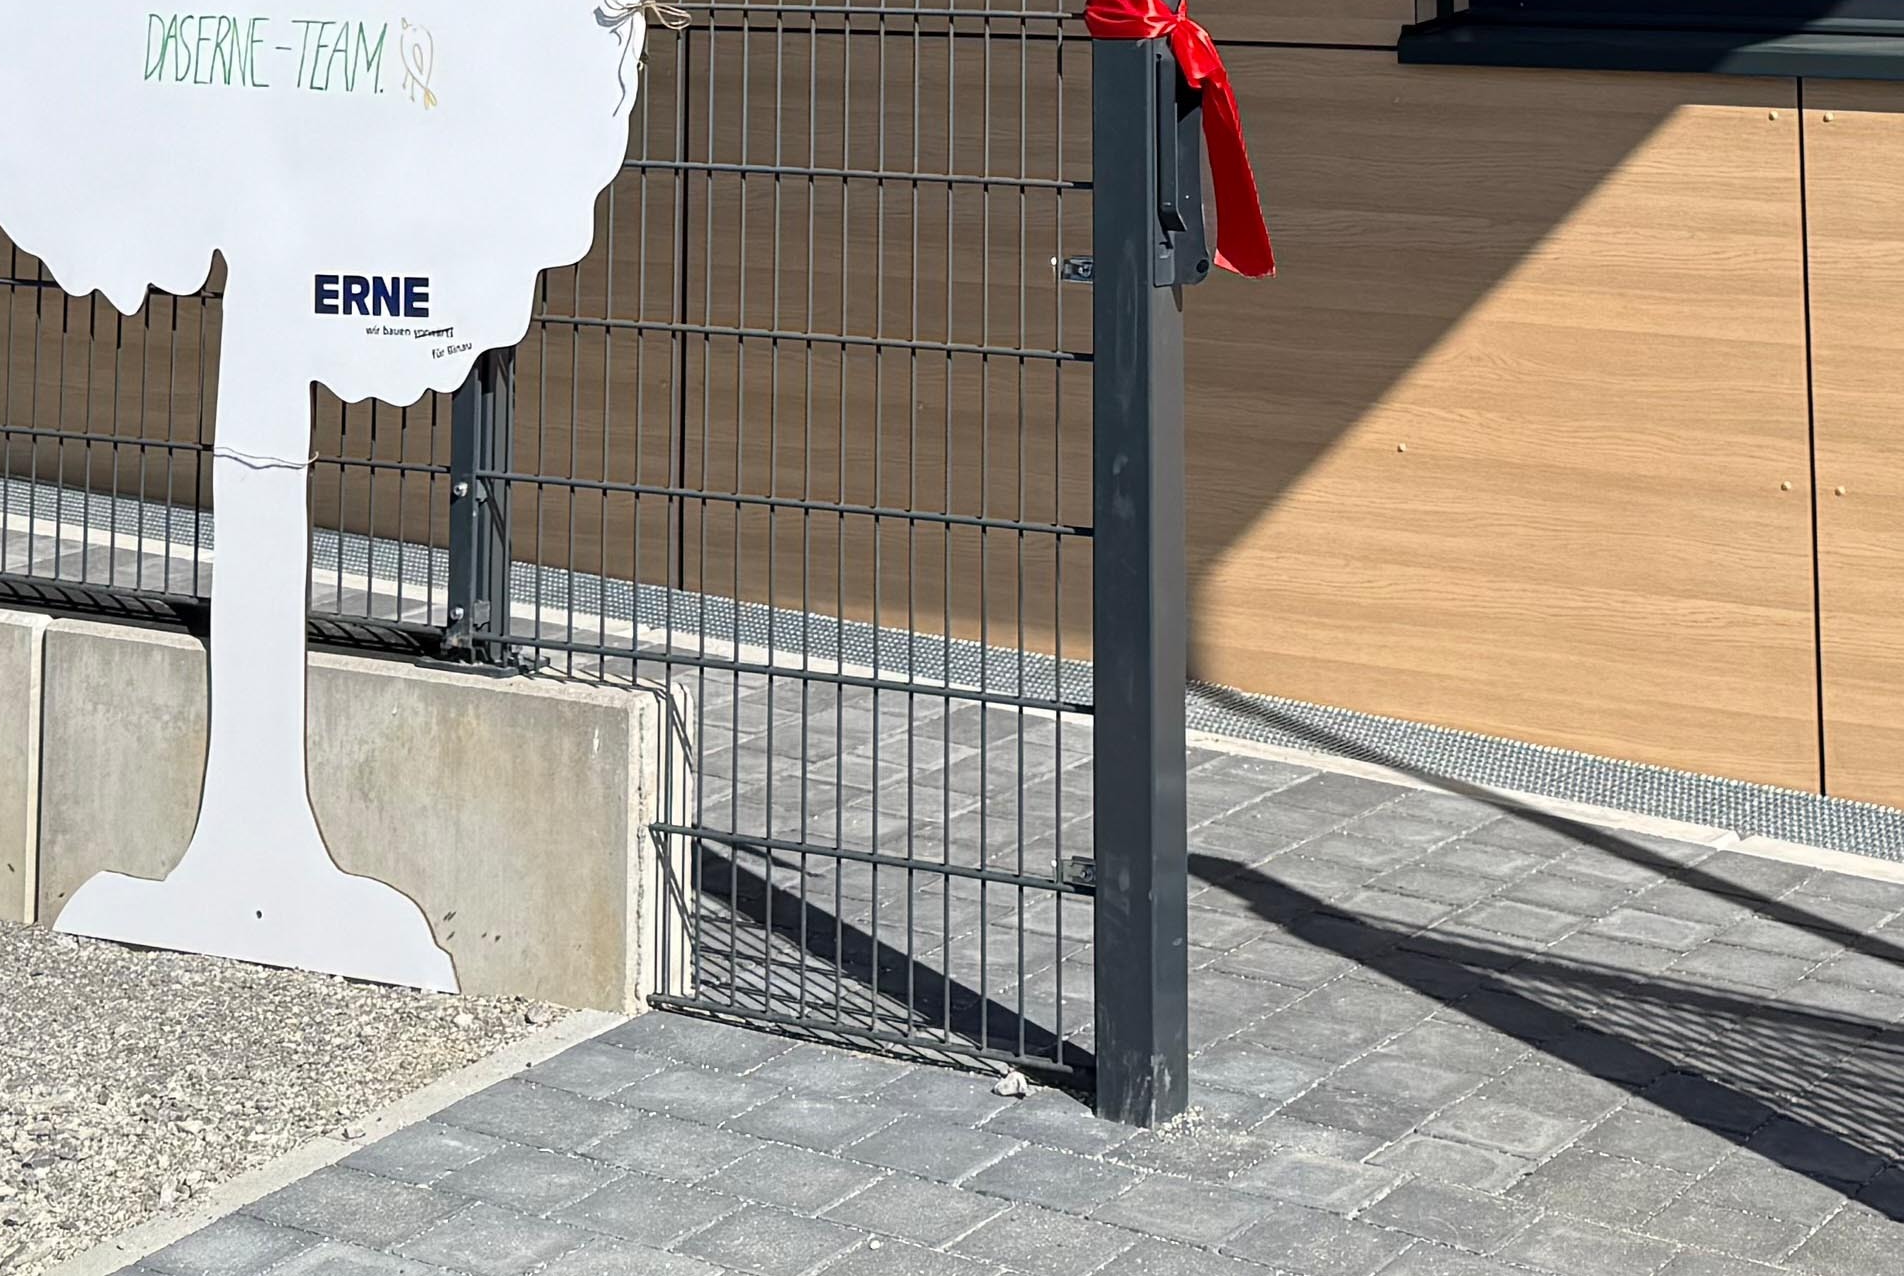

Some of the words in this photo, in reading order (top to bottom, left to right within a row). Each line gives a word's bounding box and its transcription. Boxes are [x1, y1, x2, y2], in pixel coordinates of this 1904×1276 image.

[314, 274, 429, 318] ERNE
[365, 325, 380, 335] wir
[383, 325, 411, 336] bauen
